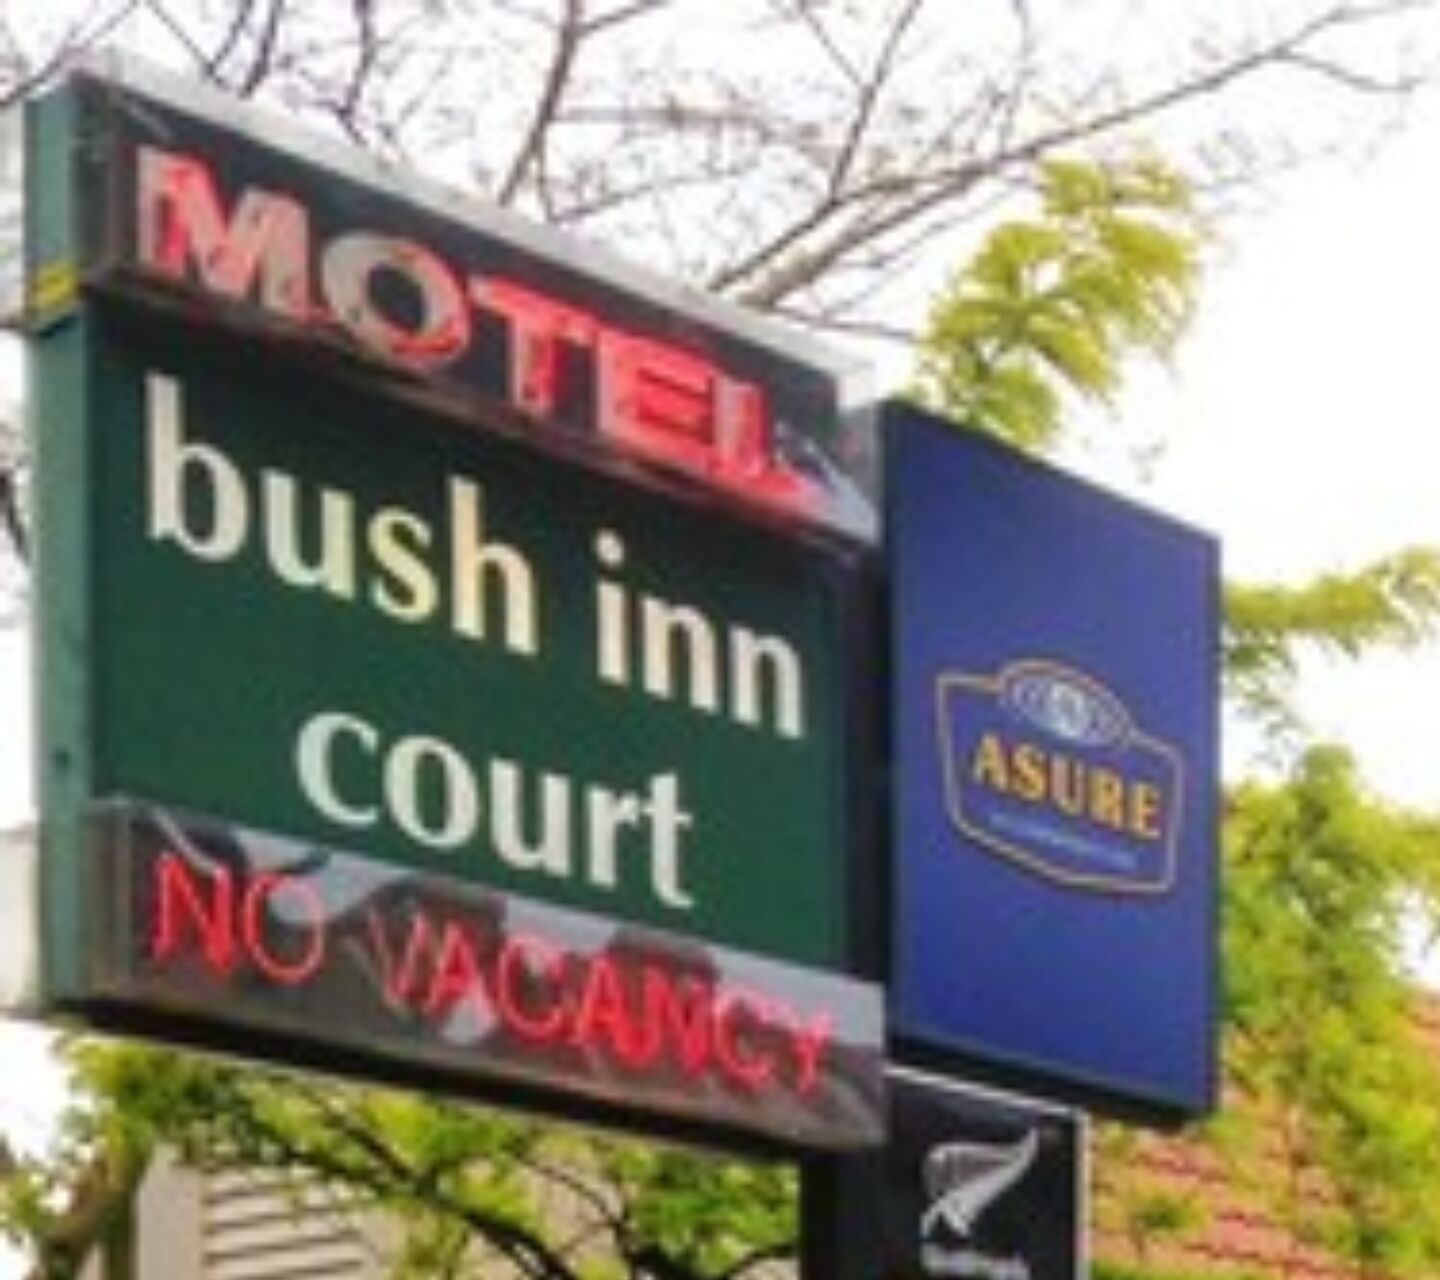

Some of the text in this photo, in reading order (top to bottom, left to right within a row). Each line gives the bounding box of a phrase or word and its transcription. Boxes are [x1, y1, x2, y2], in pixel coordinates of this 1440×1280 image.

[136, 146, 822, 516] MOTEL
[145, 372, 802, 739] bush inn
[296, 711, 693, 908] court
[971, 732, 1162, 841] ASURE
[149, 850, 836, 1099] NO VACANCY
